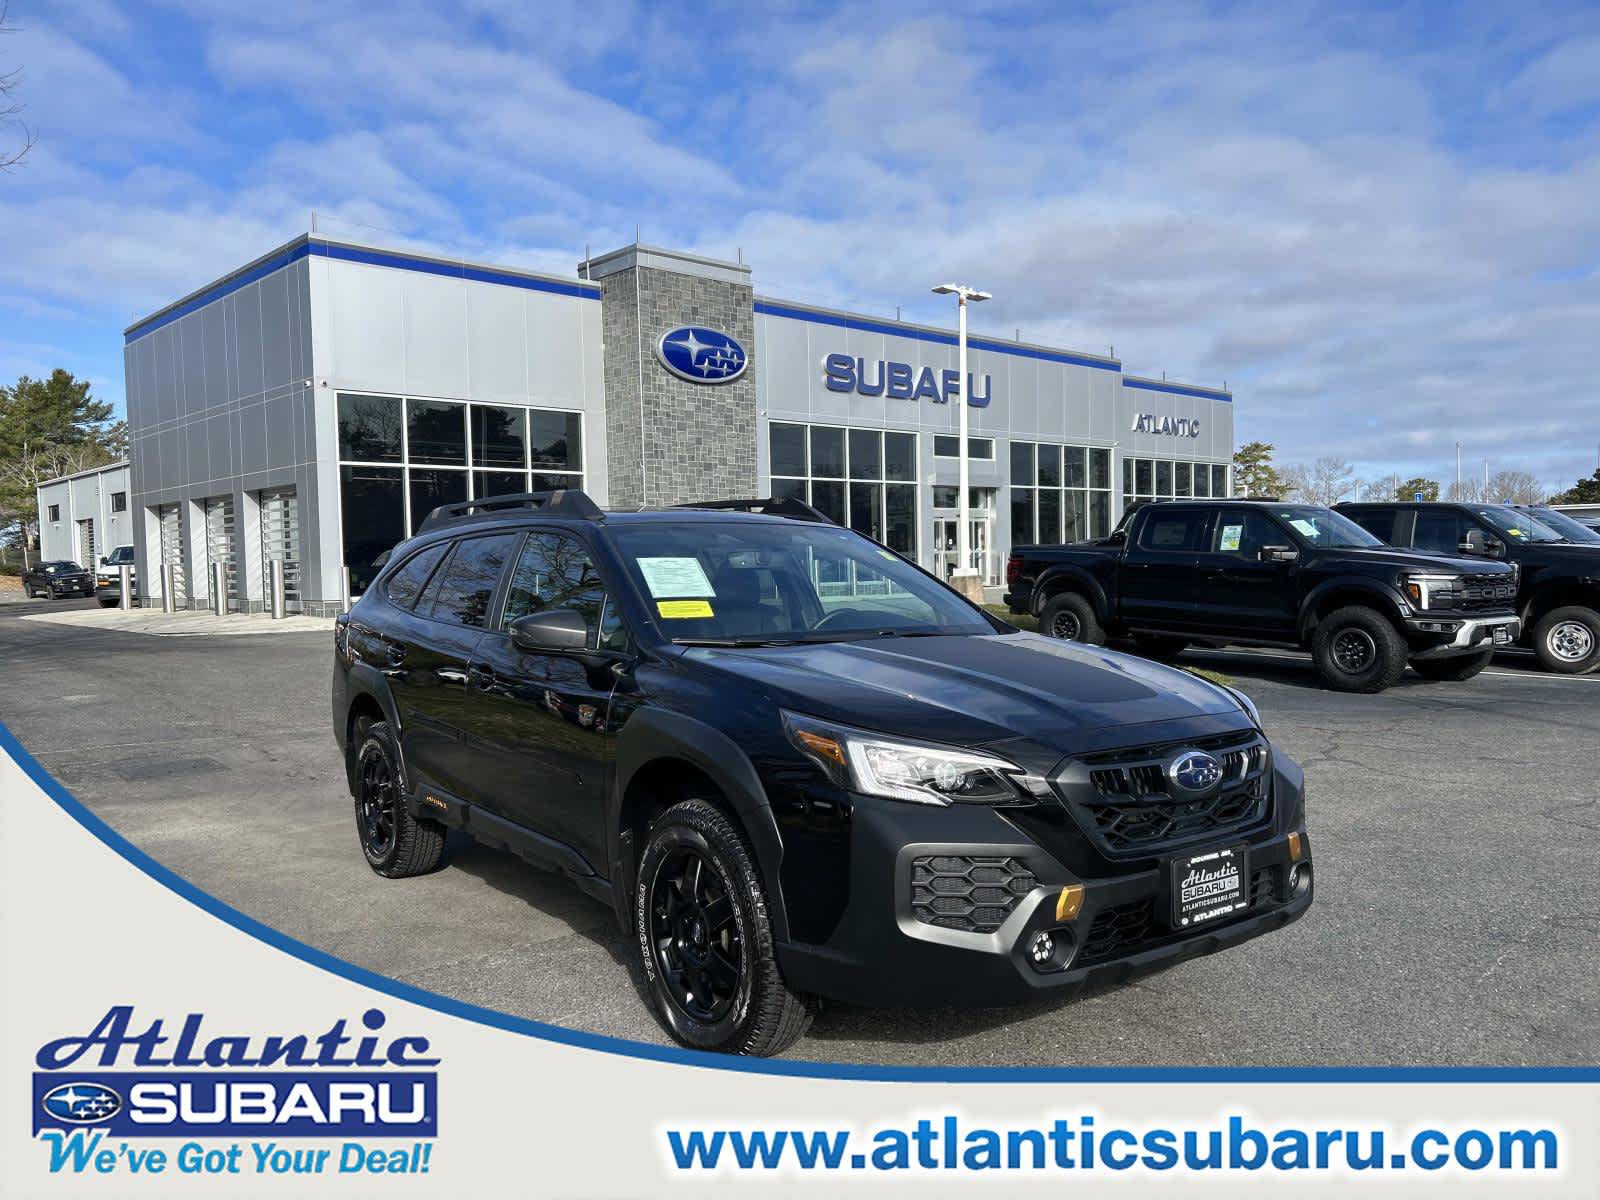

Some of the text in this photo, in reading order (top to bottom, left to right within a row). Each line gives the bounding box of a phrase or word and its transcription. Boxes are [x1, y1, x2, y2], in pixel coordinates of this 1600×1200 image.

[825, 352, 991, 408] SUBARU
[1133, 413, 1200, 438] ATLANTIC
[1181, 861, 1239, 889] Atlantic
[1183, 879, 1226, 900] SUBARU
